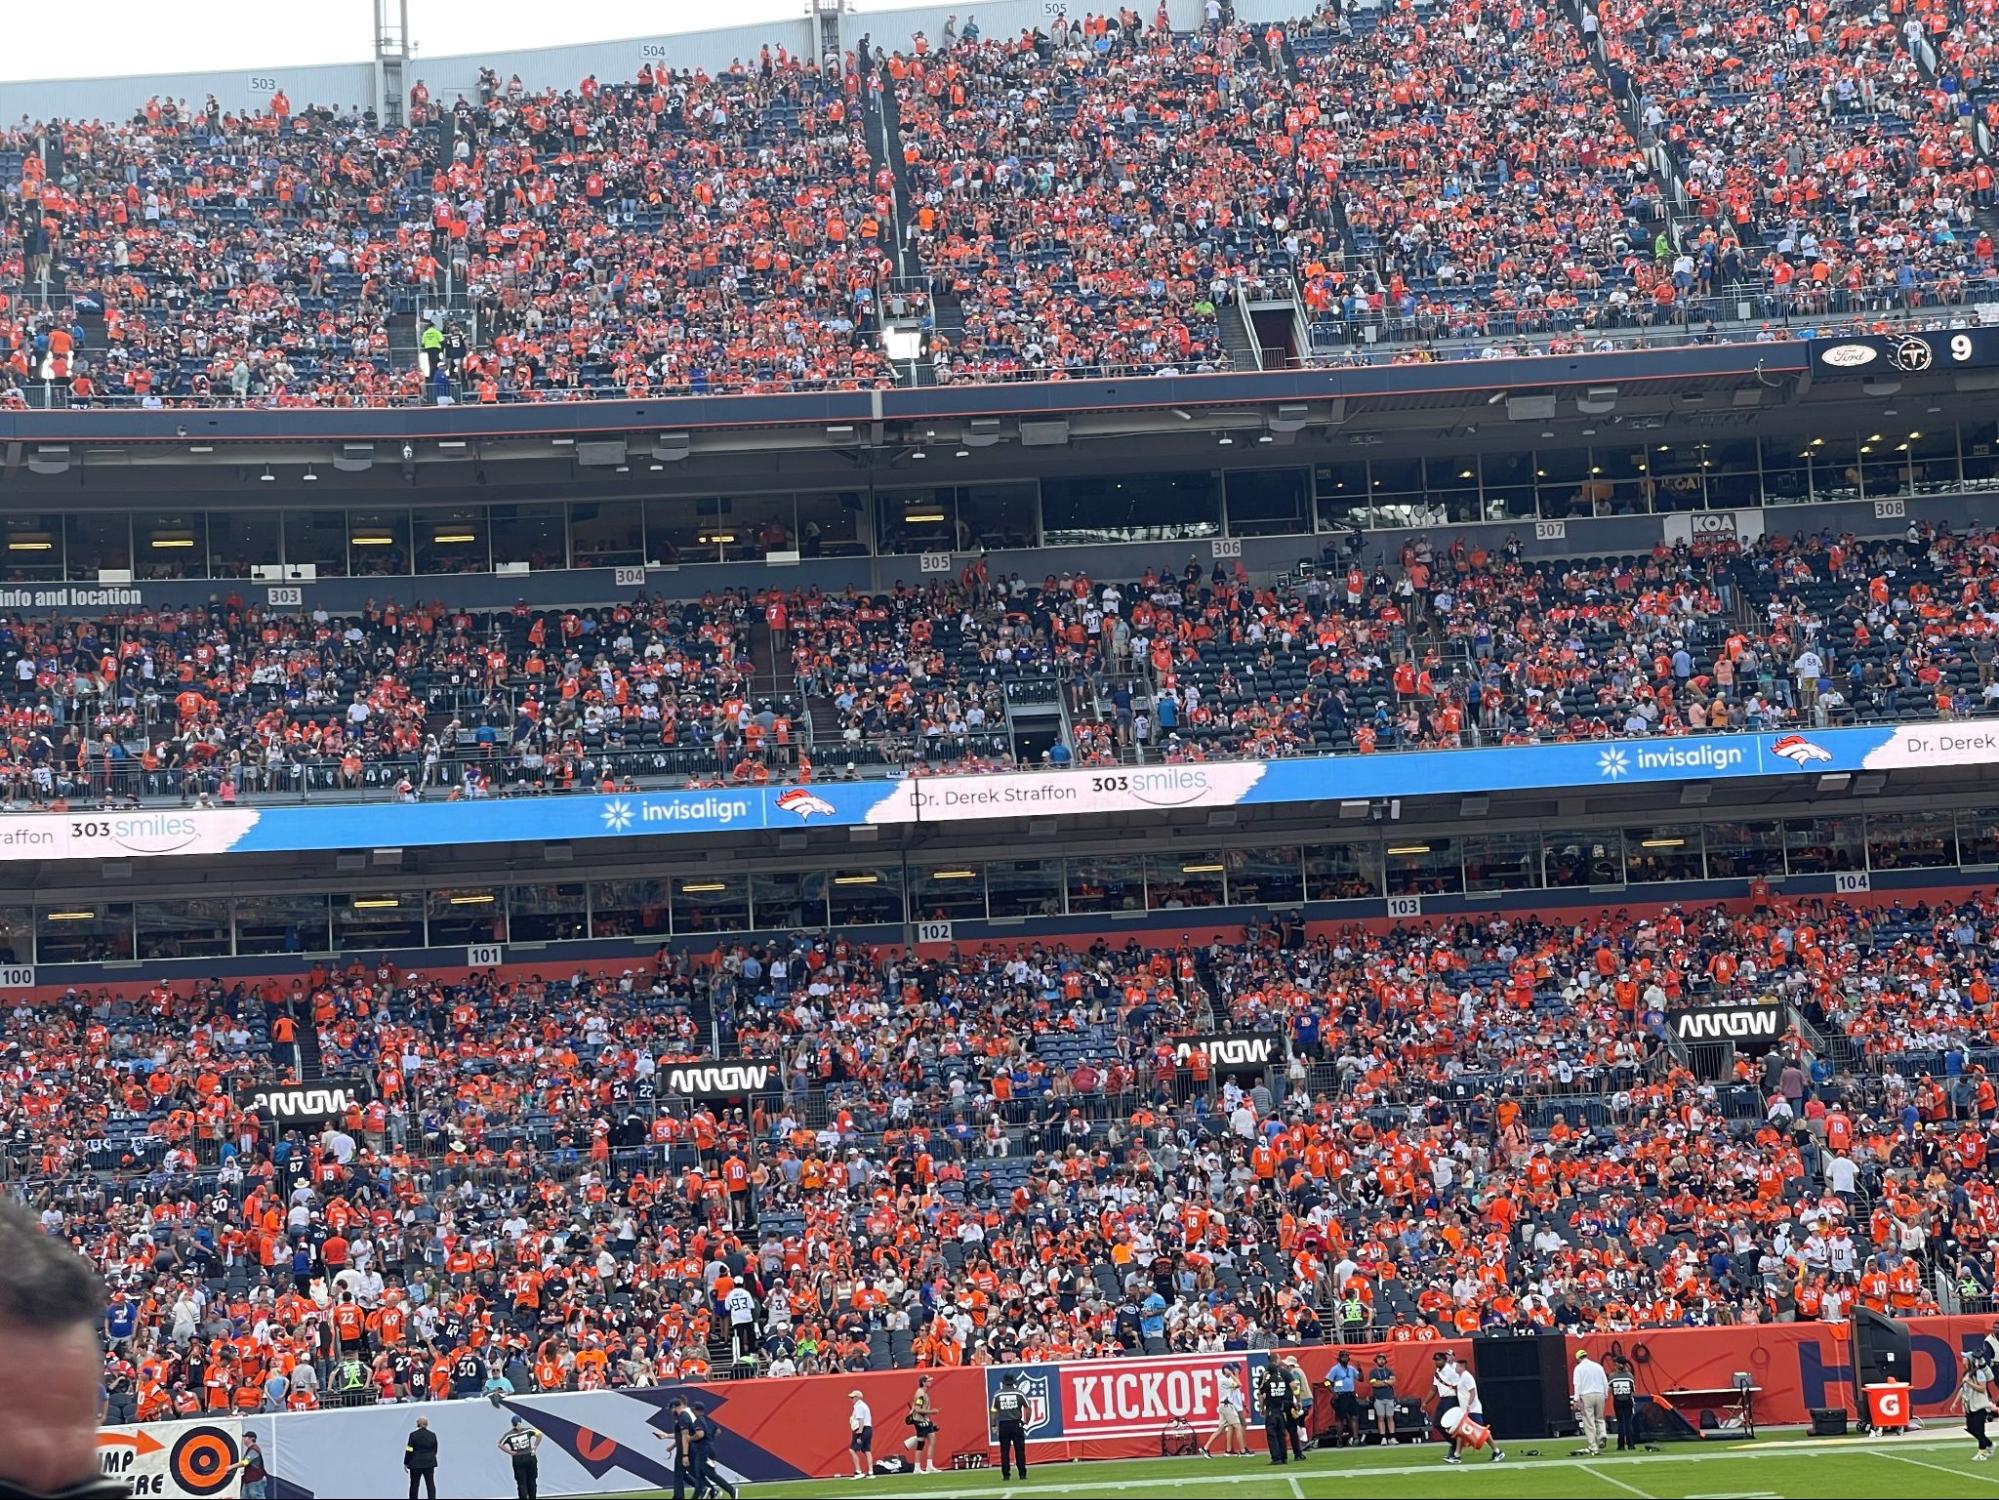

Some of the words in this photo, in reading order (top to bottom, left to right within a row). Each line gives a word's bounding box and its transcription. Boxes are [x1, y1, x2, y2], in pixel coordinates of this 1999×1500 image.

[1045, 3, 1067, 14] 505
[643, 45, 666, 56] 504
[251, 78, 276, 90] 503
[1950, 335, 1973, 361] 9
[1834, 348, 1865, 362] Ford
[1876, 503, 1904, 516] 308
[1692, 516, 1735, 531] KOA
[1538, 523, 1563, 538] 307
[1214, 542, 1240, 554] 306
[922, 557, 949, 569] 305
[617, 569, 643, 583] 304
[1349, 574, 1358, 584] 10
[1375, 576, 1384, 585] 24
[0, 589, 32, 607] info
[35, 588, 68, 606] and
[71, 588, 142, 606] location
[271, 590, 299, 603] 303
[770, 608, 777, 619] 7
[731, 682, 738, 693] 7
[728, 704, 738, 714] 10
[1451, 715, 1457, 725] 2
[1907, 738, 1934, 754] Dr.
[1940, 734, 1998, 752] Derek
[1637, 745, 1742, 769] invisalign
[1092, 777, 1128, 792] 303
[1133, 768, 1207, 791] smiles
[909, 792, 939, 807] Dr.
[945, 788, 999, 806] Derek
[1004, 785, 1077, 802] Straffon
[642, 798, 747, 823] invisalign
[71, 822, 110, 838] 303
[115, 815, 197, 838] smiles
[1838, 874, 1868, 891] 104
[1390, 899, 1418, 915] 103
[922, 924, 949, 940] 102
[1800, 931, 1807, 943] 2
[472, 948, 498, 963] 101
[3, 969, 32, 985] 100
[1832, 966, 1838, 976] 2
[1067, 976, 1079, 986] 77
[161, 994, 167, 1005] 2
[1294, 995, 1304, 1006] 10
[1678, 1011, 1777, 1039] ARROW
[91, 1032, 102, 1043] 23
[974, 1055, 985, 1066] 58
[1197, 1057, 1207, 1068] 12
[670, 1065, 768, 1093] ARROW
[613, 1085, 628, 1099] 24
[639, 1084, 654, 1098] 22
[656, 1126, 670, 1139] 58
[1833, 1122, 1844, 1133] 18
[1424, 1146, 1431, 1158] 2
[1926, 1142, 1934, 1156] 7
[1260, 1152, 1269, 1163] 14
[1334, 1154, 1345, 1166] 18
[289, 1161, 304, 1173] 87
[731, 1165, 744, 1180] 10
[1536, 1164, 1546, 1175] 10
[323, 1169, 334, 1181] 18
[1384, 1169, 1395, 1181] 10
[1762, 1169, 1772, 1181] 10
[1369, 1190, 1376, 1200] 2
[211, 1197, 228, 1214] 30
[1188, 1216, 1199, 1228] 18
[1320, 1215, 1328, 1227] 10
[1436, 1242, 1445, 1255] 7
[1819, 1246, 1826, 1257] 2
[1834, 1248, 1844, 1261] 10
[684, 1263, 698, 1273] 96
[518, 1280, 530, 1294] 14
[1872, 1280, 1886, 1293] 10
[1898, 1278, 1913, 1291] 14
[1840, 1290, 1852, 1300] 18
[731, 1297, 748, 1312] 93
[775, 1299, 783, 1311] 3
[341, 1312, 354, 1325] 22
[384, 1314, 398, 1327] 49
[1664, 1310, 1673, 1320] 5
[446, 1324, 459, 1337] 49
[668, 1326, 678, 1338] 10
[1418, 1330, 1432, 1341] 49
[244, 1345, 252, 1357] 2
[395, 1357, 412, 1371] 27
[458, 1361, 477, 1377] 30
[662, 1361, 675, 1374] 10
[154, 1365, 162, 1380] 7
[543, 1366, 552, 1381] 0
[1879, 1394, 1900, 1417] G
